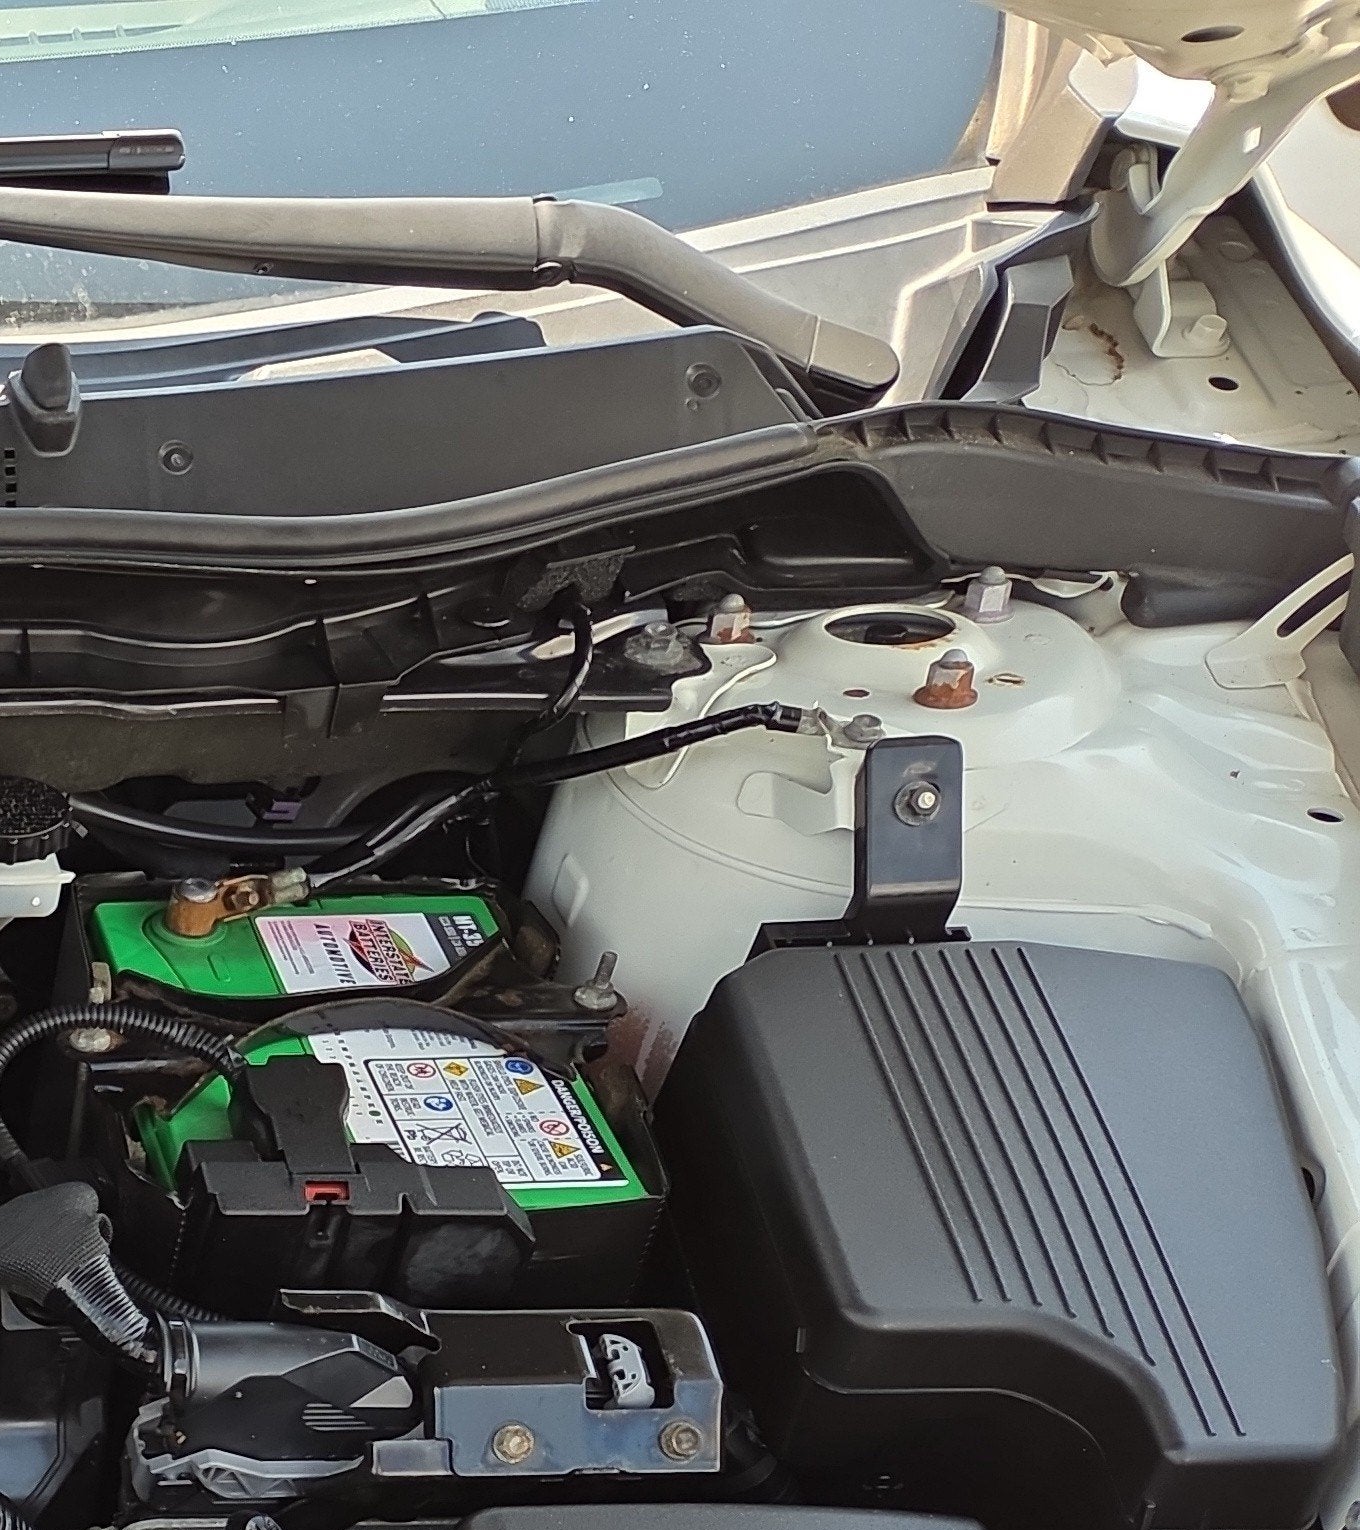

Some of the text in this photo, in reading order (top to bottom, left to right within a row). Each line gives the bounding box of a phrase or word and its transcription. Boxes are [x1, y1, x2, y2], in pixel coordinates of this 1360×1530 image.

[314, 923, 357, 984] AUTOMOTIVE
[354, 924, 394, 981] BATTERIES
[368, 920, 410, 985] INTERSTATE
[551, 1079, 604, 1154] DANGER/POISON
